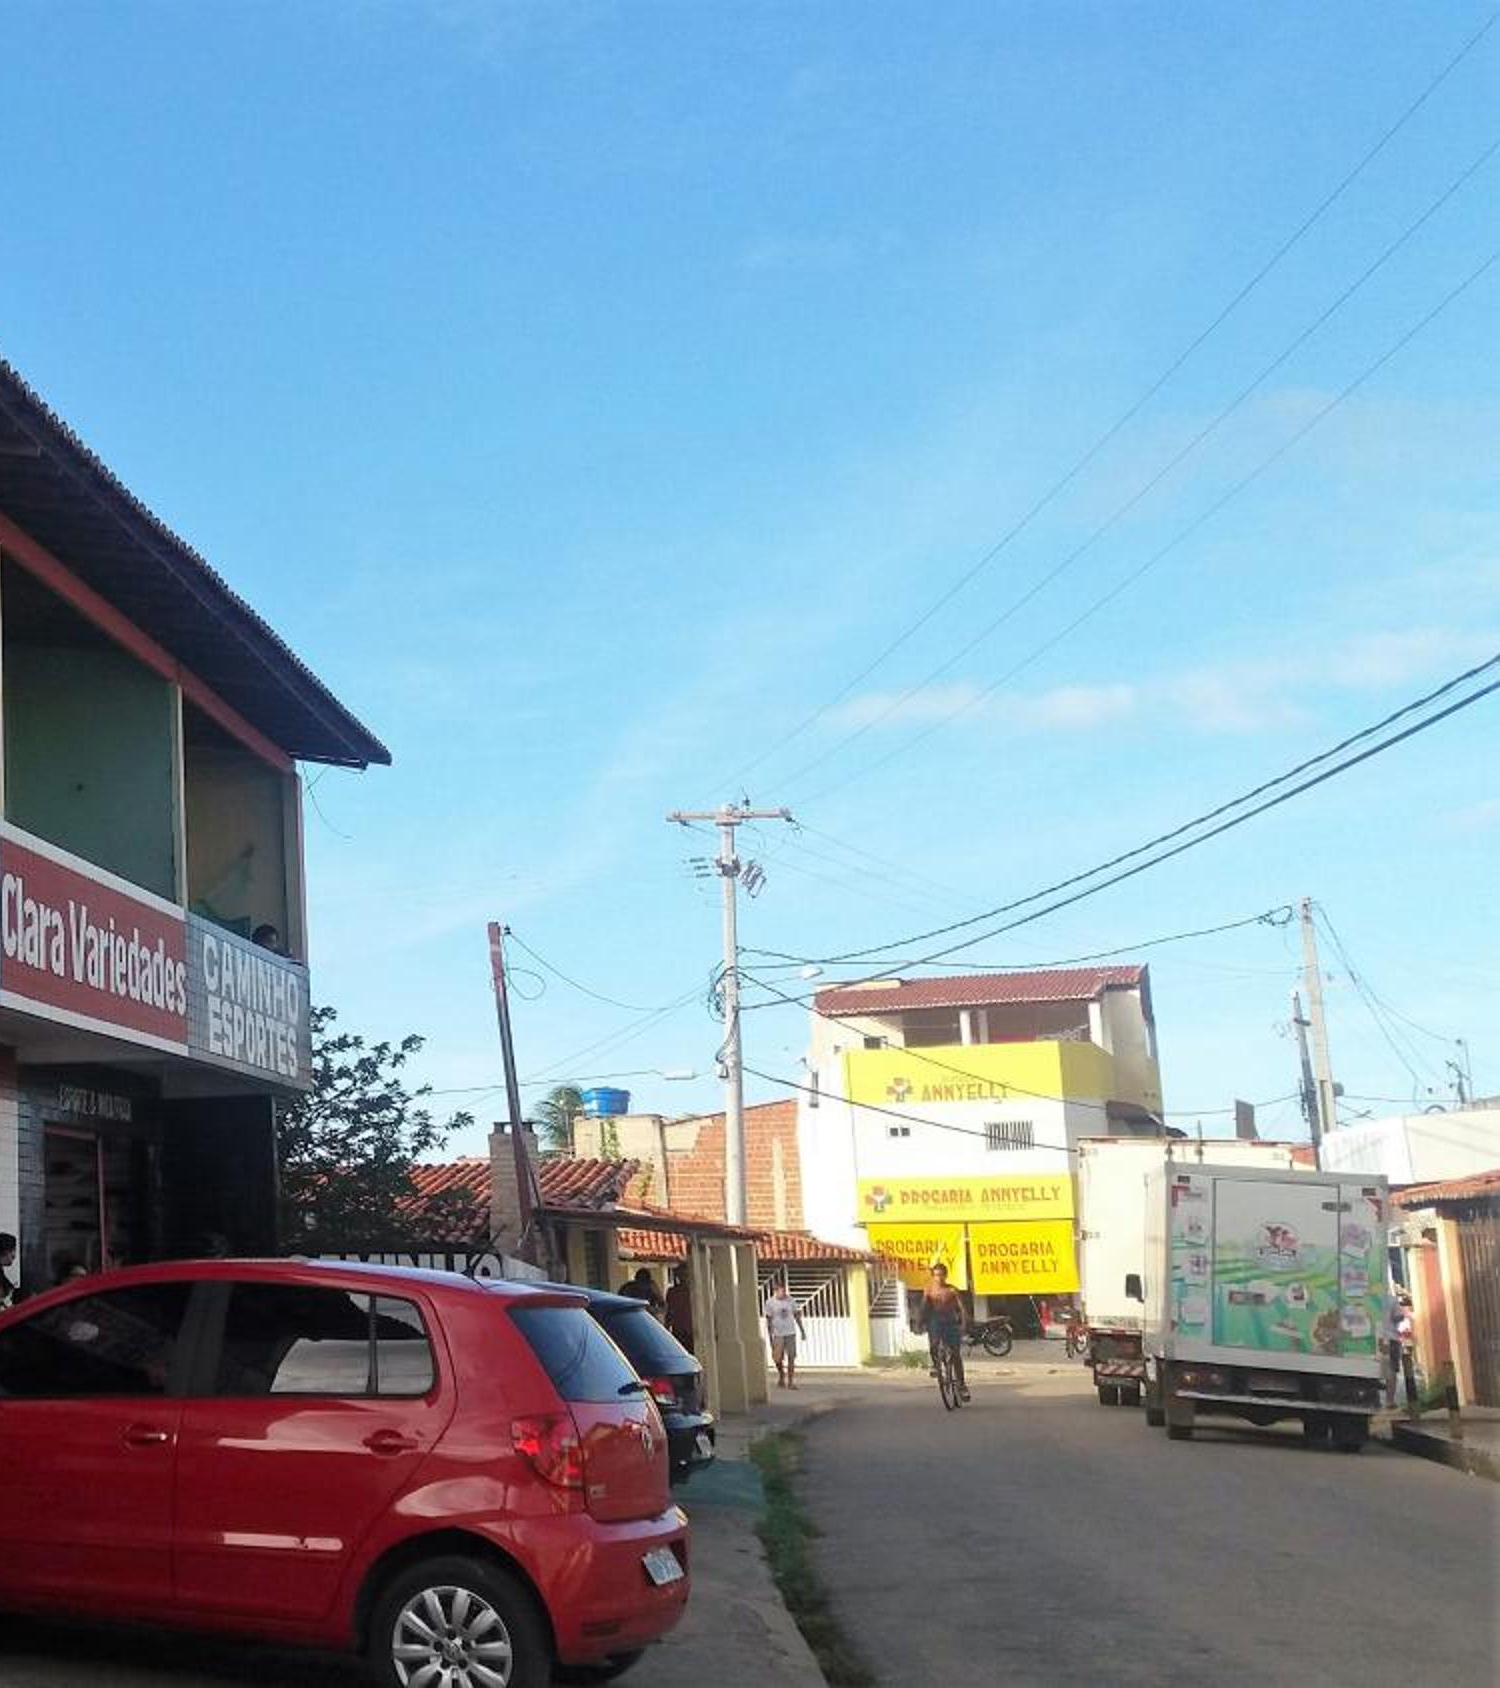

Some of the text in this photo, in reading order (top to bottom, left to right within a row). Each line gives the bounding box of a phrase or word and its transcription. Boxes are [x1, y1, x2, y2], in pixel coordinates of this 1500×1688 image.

[1, 872, 188, 1017] Clara Variedades
[202, 932, 300, 1026] CAMINHO
[205, 994, 299, 1079] ESPORTES
[900, 1185, 1062, 1206] DROGARIA ANNYELLY
[977, 1241, 1055, 1258] DROGARIA
[979, 1259, 1059, 1276] ANNYELLY
